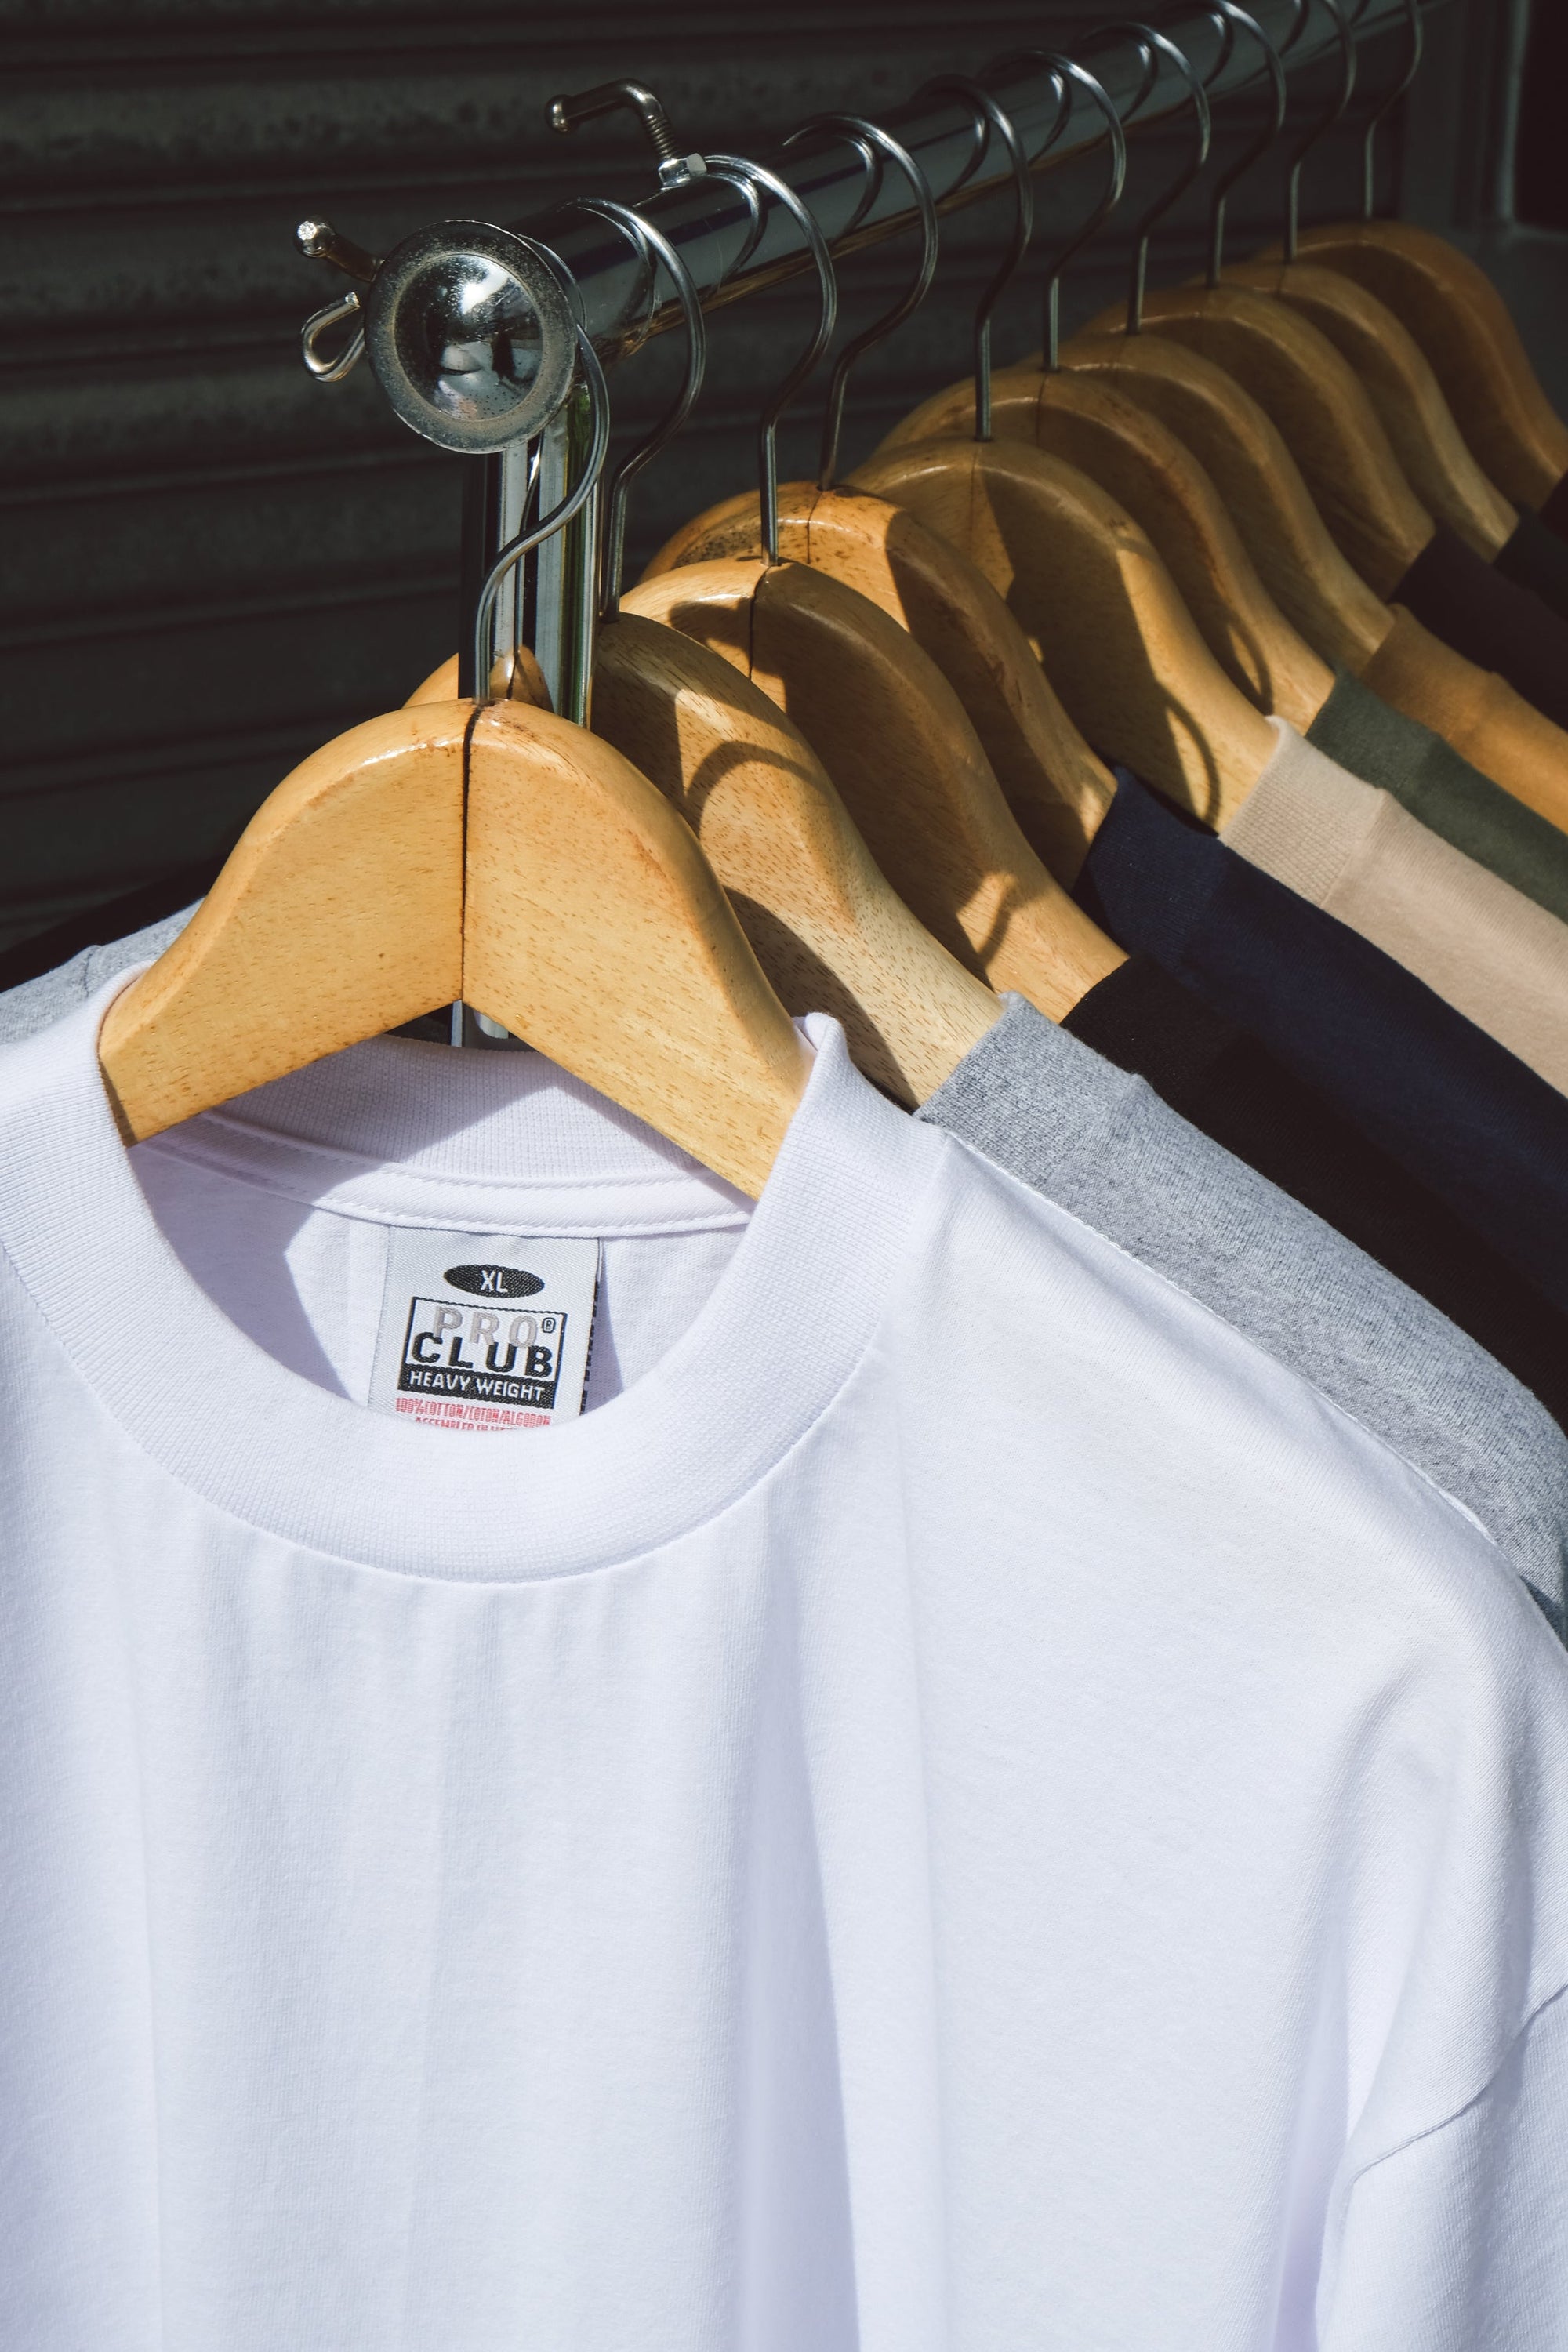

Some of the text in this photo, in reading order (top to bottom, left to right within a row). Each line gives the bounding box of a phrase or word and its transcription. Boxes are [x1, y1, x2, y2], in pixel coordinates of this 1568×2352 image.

[481, 1269, 509, 1293] XL
[411, 1331, 553, 1378] CLUB
[409, 1370, 545, 1401] HEAVY WEIGHT
